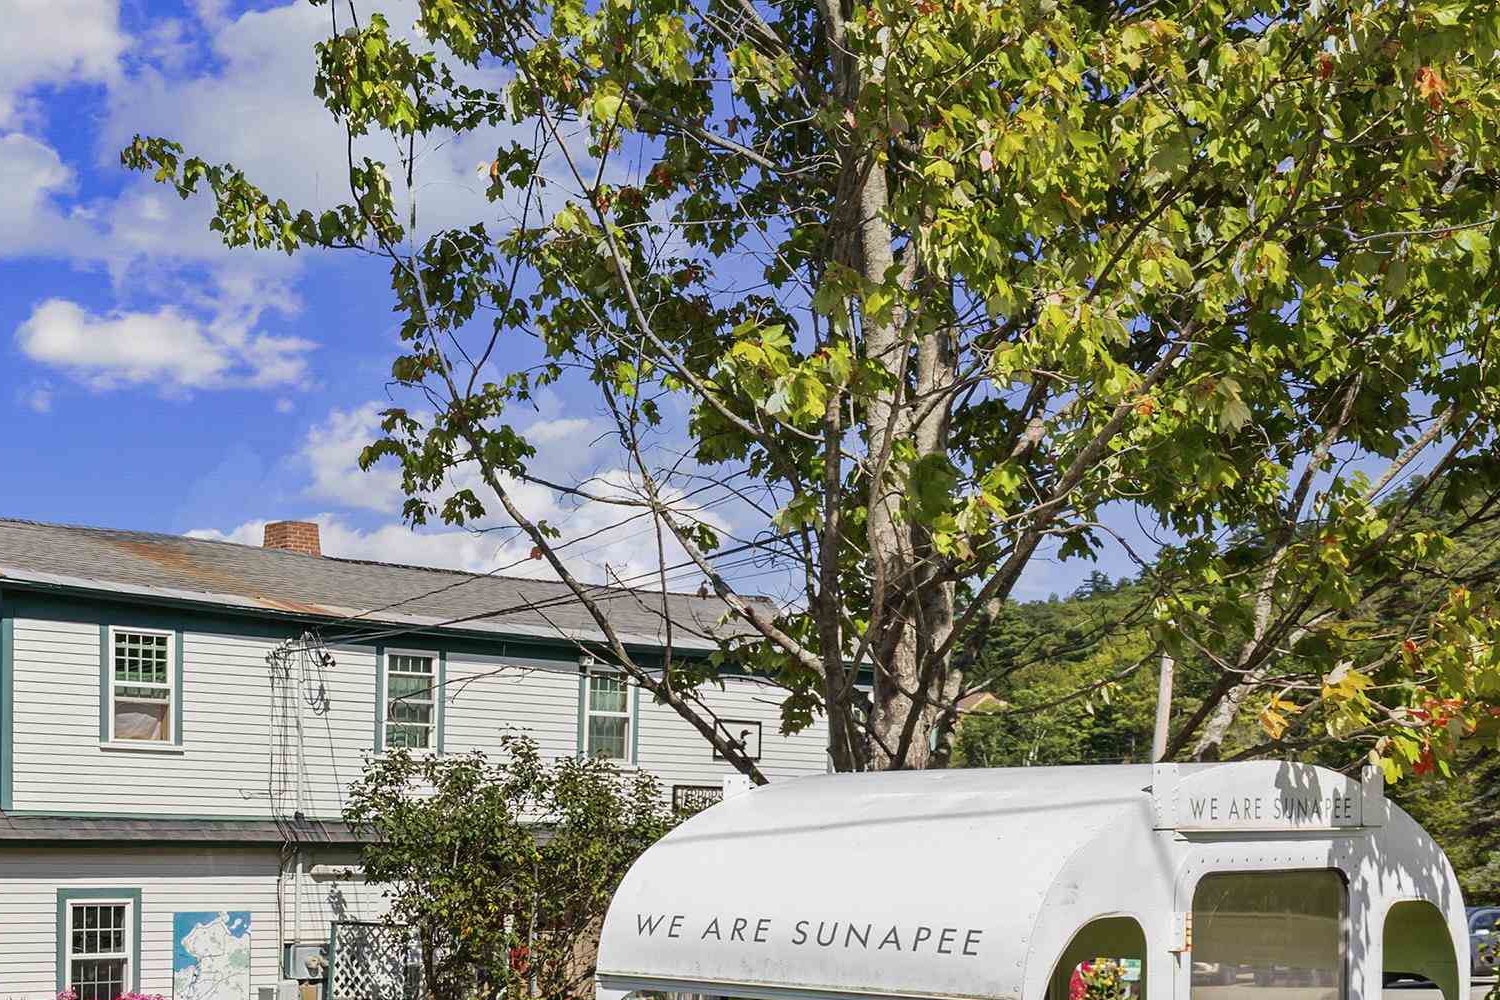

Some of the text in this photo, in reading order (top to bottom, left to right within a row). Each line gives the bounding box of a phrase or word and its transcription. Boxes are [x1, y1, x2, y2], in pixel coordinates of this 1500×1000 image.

[1189, 796, 1352, 820] WE ARE SUNAPEE
[636, 913, 984, 957] WE ARE SUNAPEE
